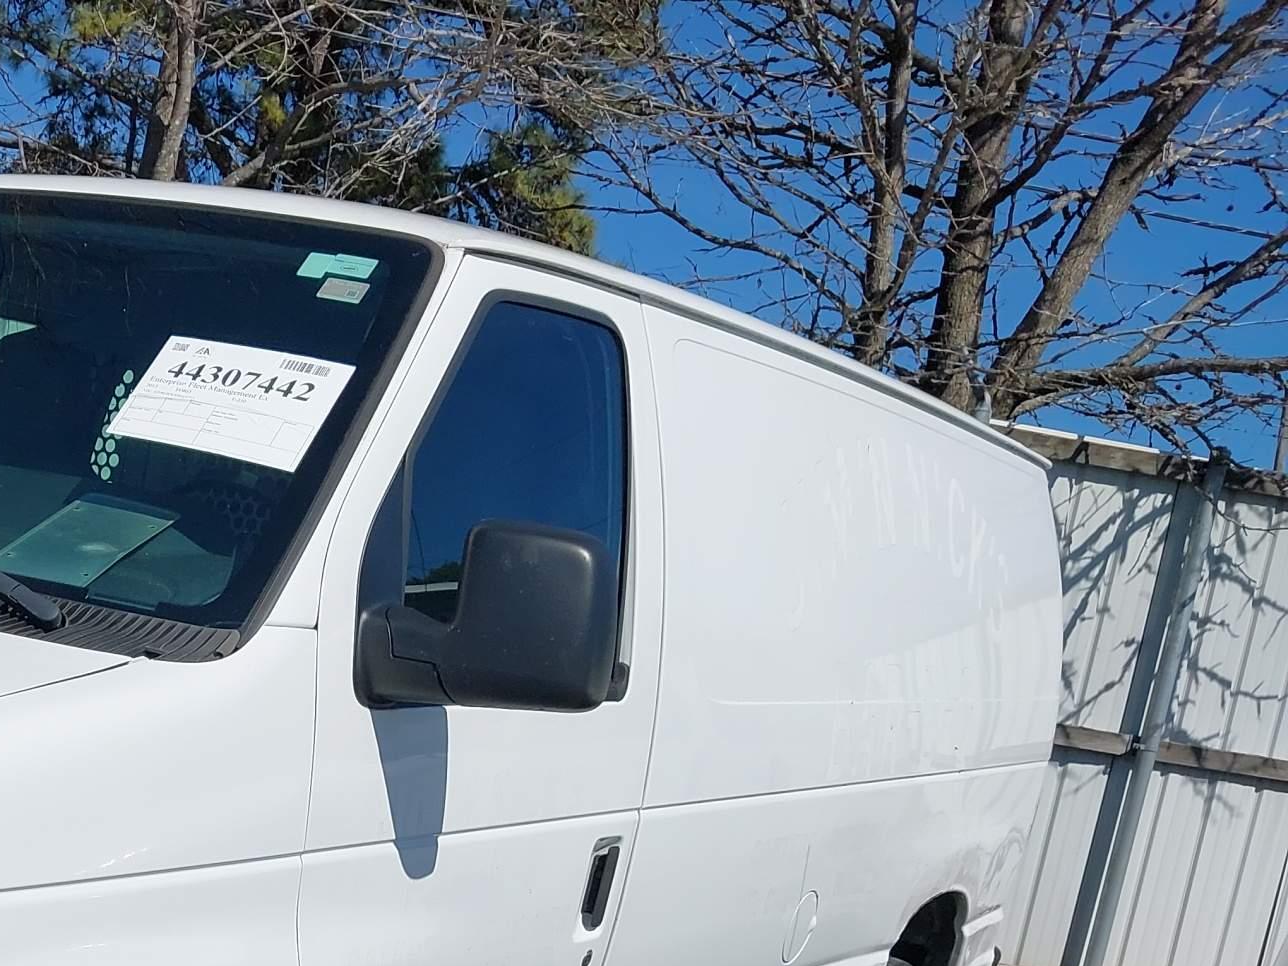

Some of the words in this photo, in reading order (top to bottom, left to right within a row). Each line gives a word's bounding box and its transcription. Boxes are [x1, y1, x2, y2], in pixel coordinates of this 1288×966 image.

[150, 376, 187, 387] Enterprise
[188, 381, 207, 391] Fleet
[208, 385, 257, 400] Management
[167, 361, 316, 402] 44307442
